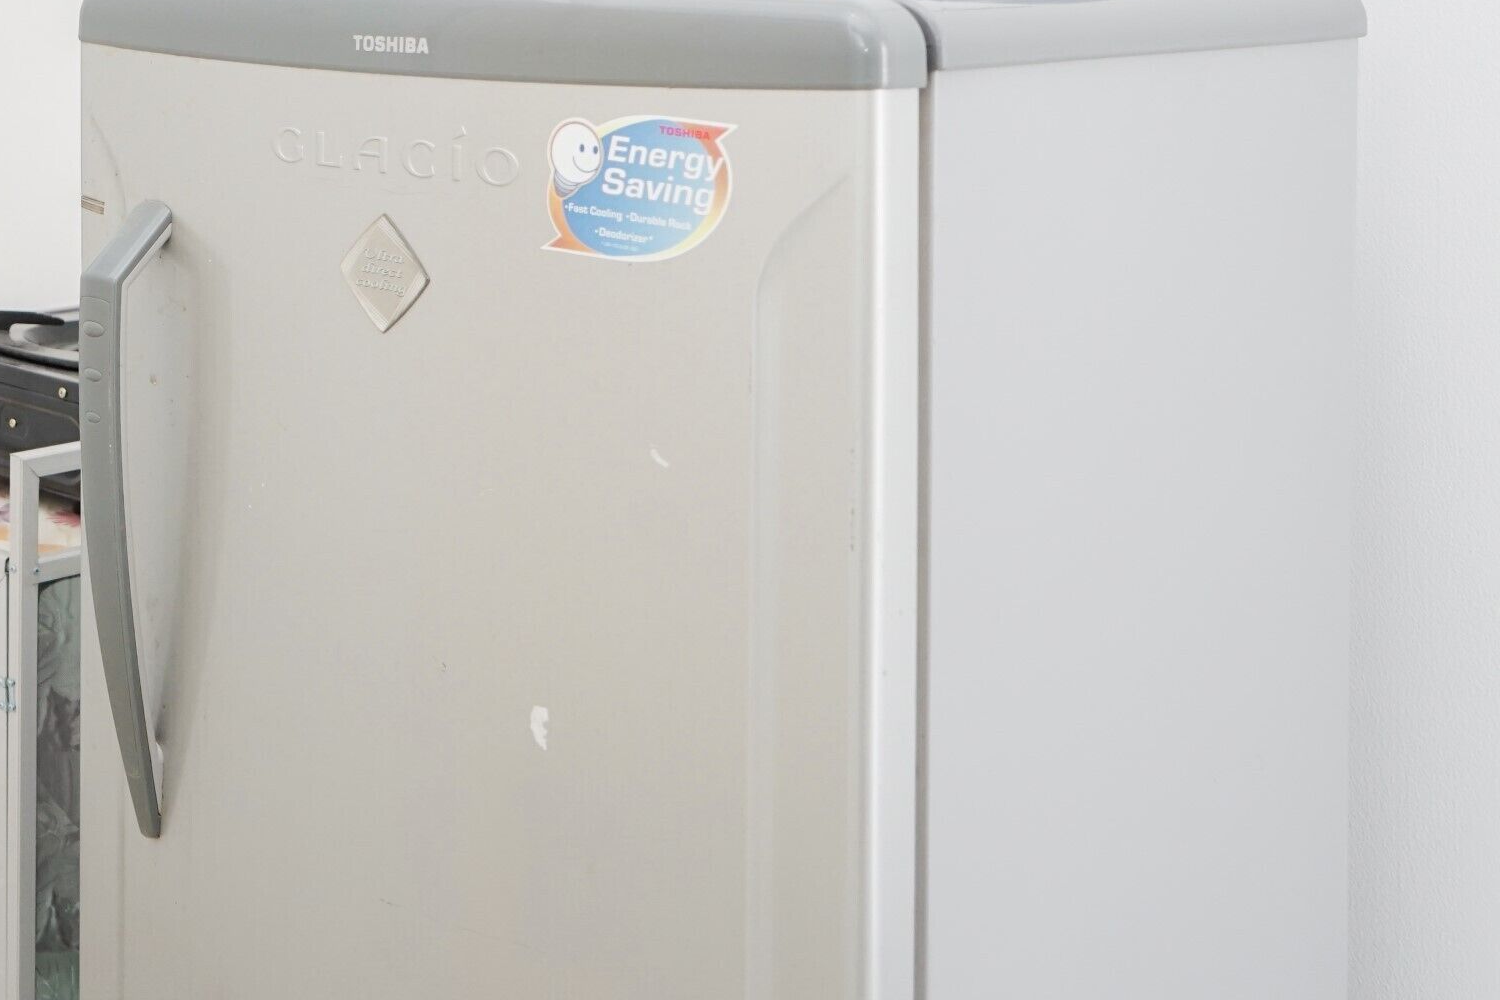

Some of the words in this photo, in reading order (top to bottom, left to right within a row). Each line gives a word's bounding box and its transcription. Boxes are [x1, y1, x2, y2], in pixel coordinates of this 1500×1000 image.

[353, 34, 429, 54] TOSHIBA
[659, 125, 711, 140] TOSHIBA
[607, 135, 724, 181] Energy
[601, 167, 714, 215] Saving
[589, 205, 623, 221] Cooling
